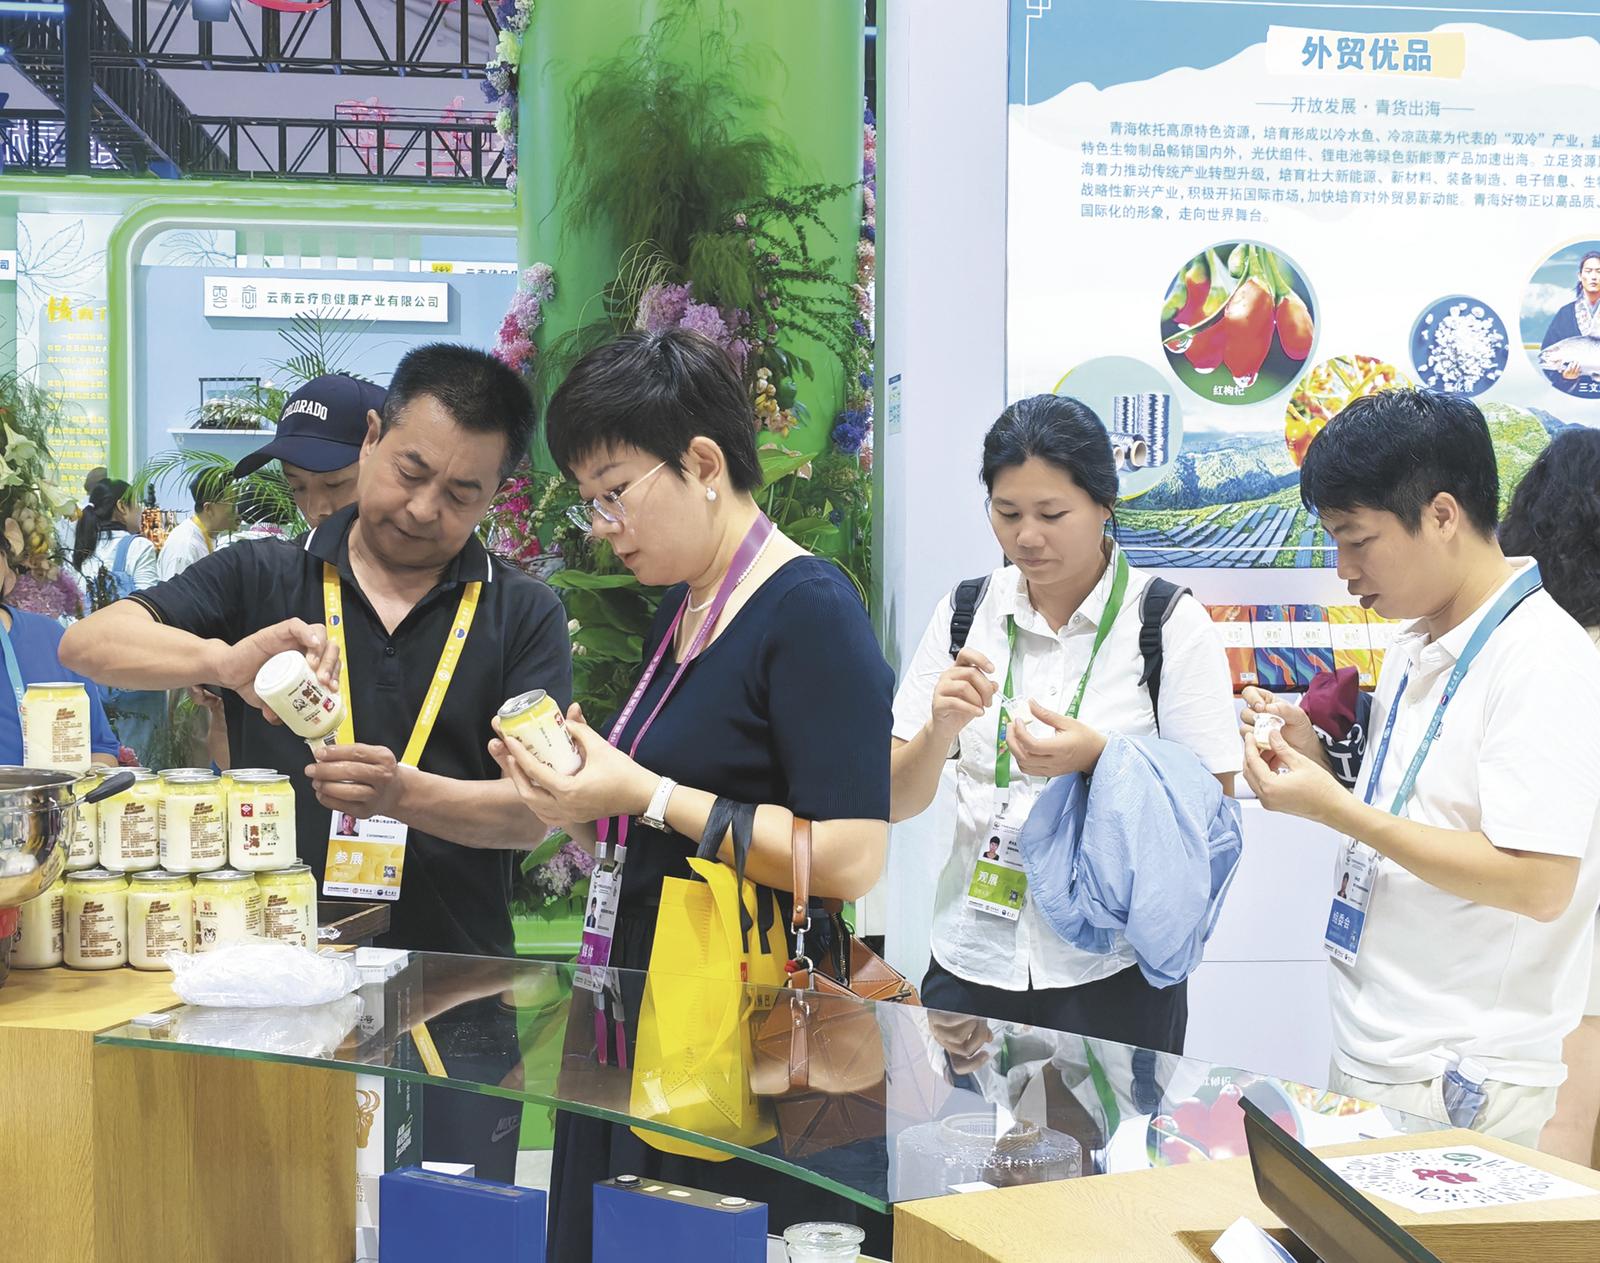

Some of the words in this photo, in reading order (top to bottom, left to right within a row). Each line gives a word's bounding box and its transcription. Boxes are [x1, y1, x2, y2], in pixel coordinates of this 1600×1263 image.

[1302, 36, 1431, 71] 外贸优品
[1081, 141, 1600, 168] 特色生物制品畅销国内外，光伏组件、锂电池等绿色新能源产品加速出海。立足资源
[1081, 162, 1600, 188] 海着力推动传统产业转型升级，培育壮大新能源、新材料、装备制造、电子信息、生
[266, 291, 439, 308] 云南云疗愈健康产业有限公司
[1213, 385, 1245, 396] 红枸杞
[1578, 382, 1600, 393] 三文
